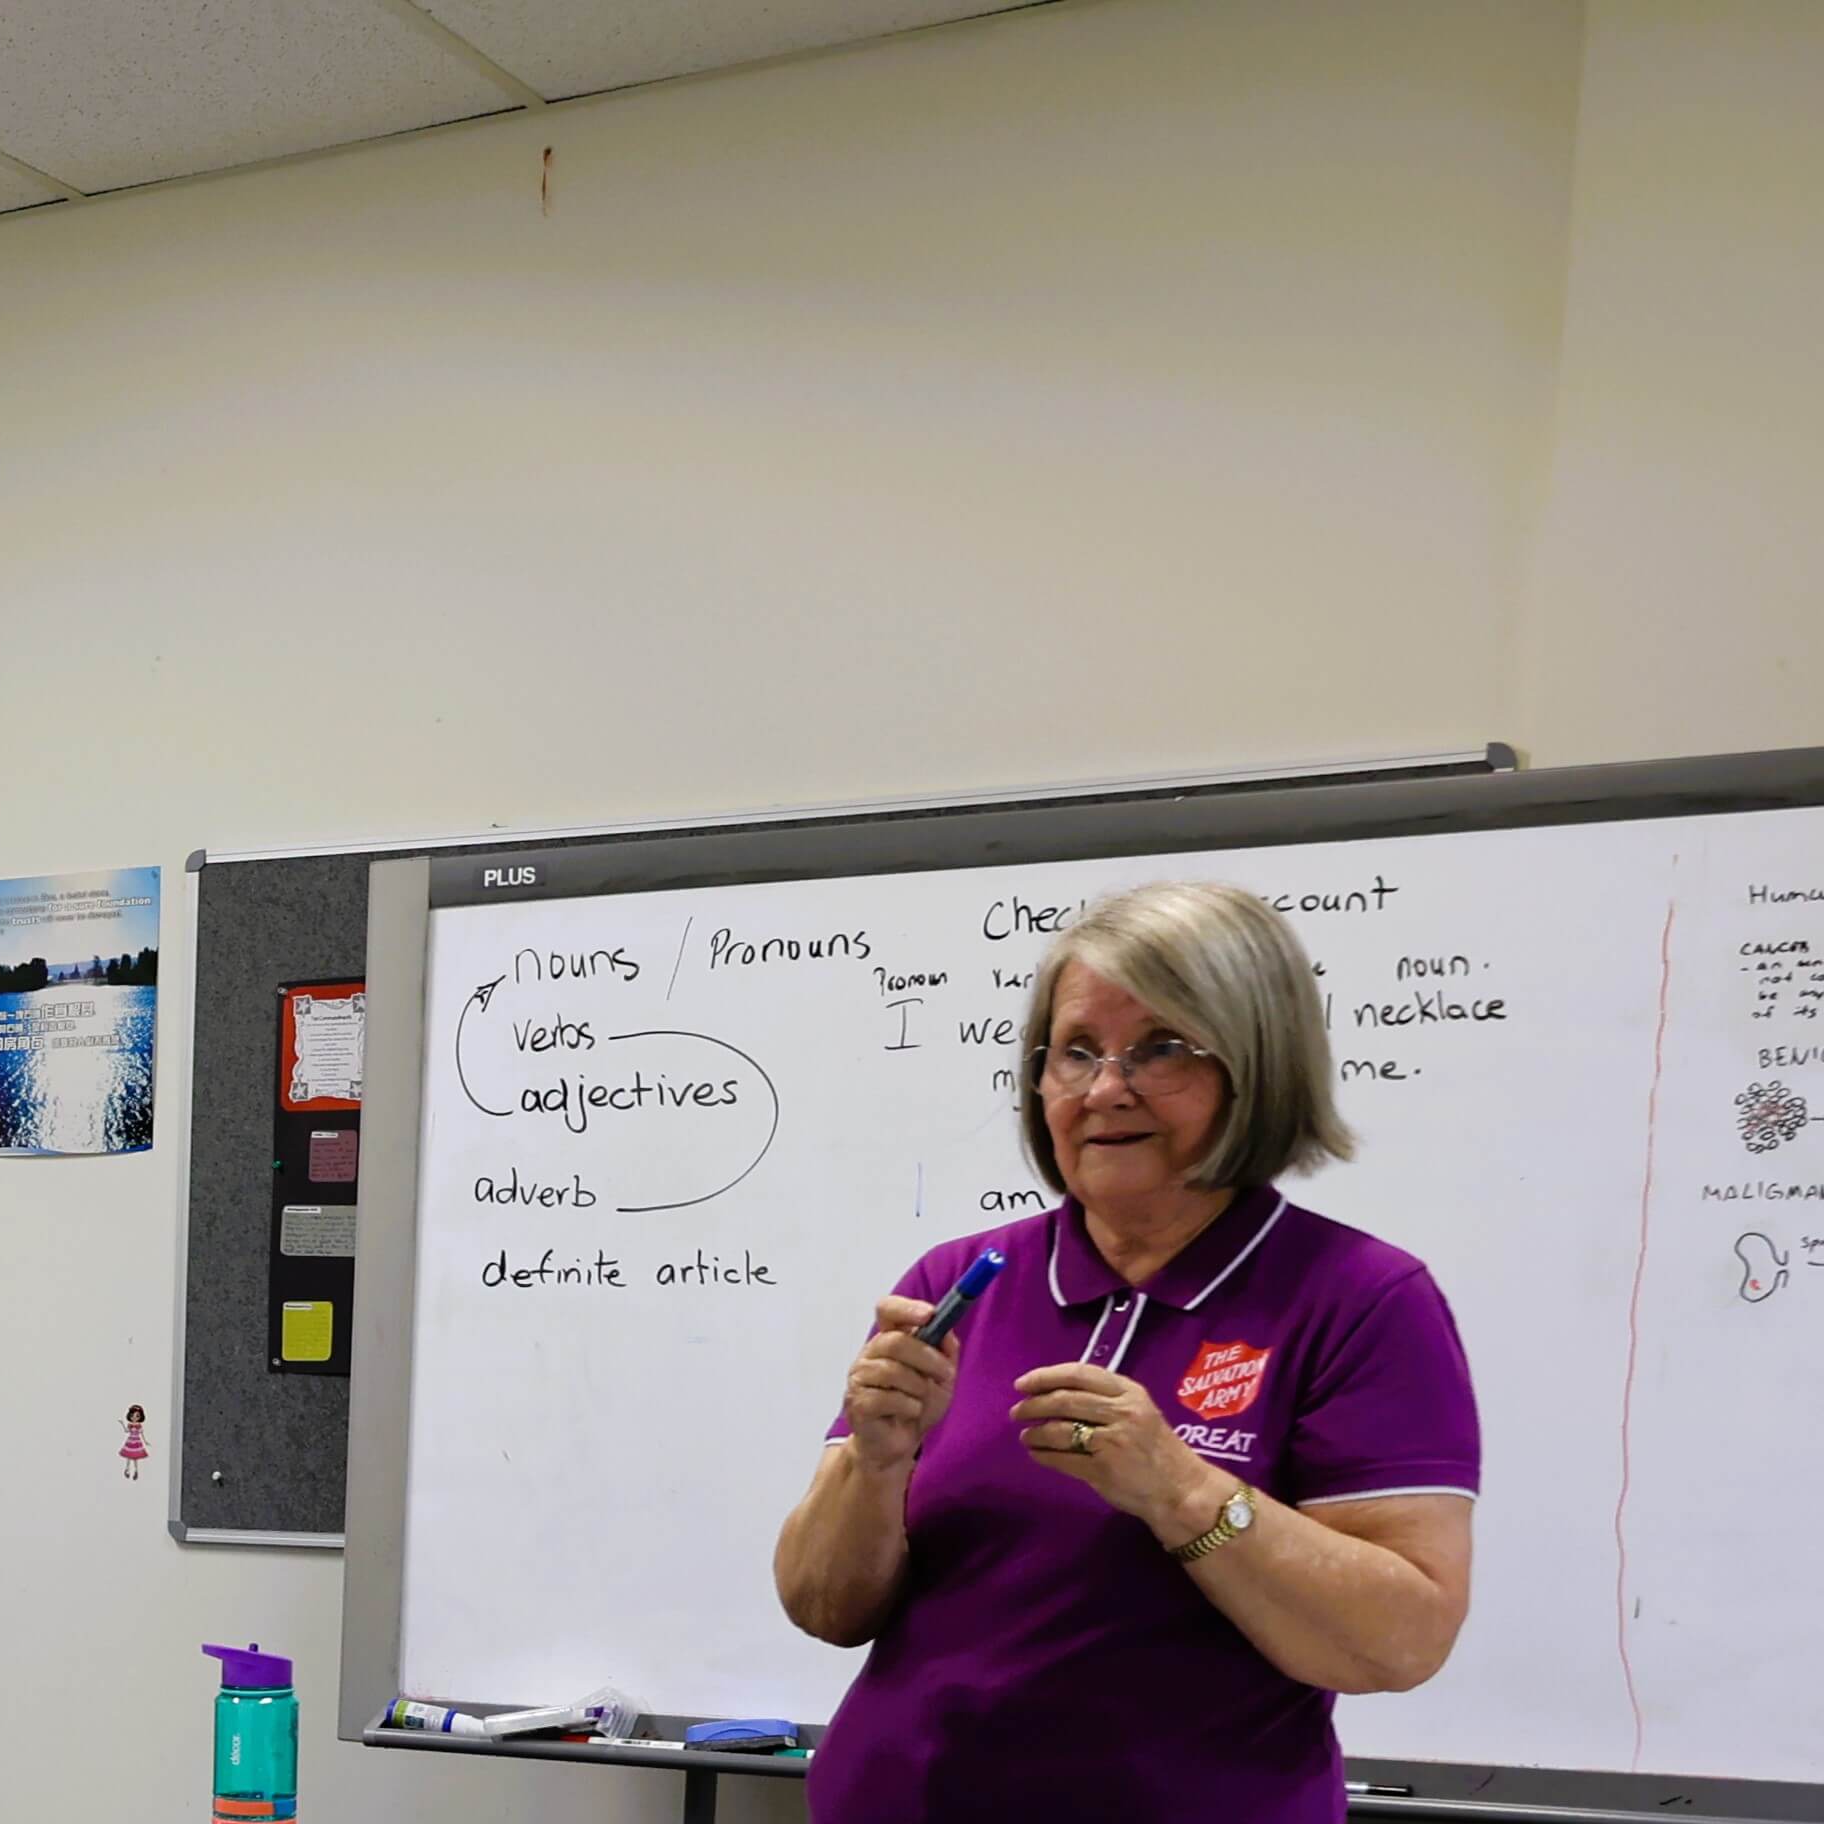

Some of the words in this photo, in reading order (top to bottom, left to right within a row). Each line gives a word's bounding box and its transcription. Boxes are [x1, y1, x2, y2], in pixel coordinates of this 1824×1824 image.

[483, 867, 536, 888] PLUS
[982, 896, 1083, 941] Chec
[1260, 875, 1399, 912] count
[514, 946, 640, 982] nouns
[710, 928, 872, 970] Pronouns
[884, 998, 925, 1050] I
[1354, 990, 1507, 1029] necklace
[520, 1072, 738, 1133] adjectives
[474, 1170, 596, 1208] adverb
[482, 1249, 626, 1288] definite
[656, 1249, 778, 1286] article
[1177, 1354, 1269, 1396] SALVATION
[1204, 1344, 1241, 1370] THE
[1197, 1379, 1257, 1411] ARMY
